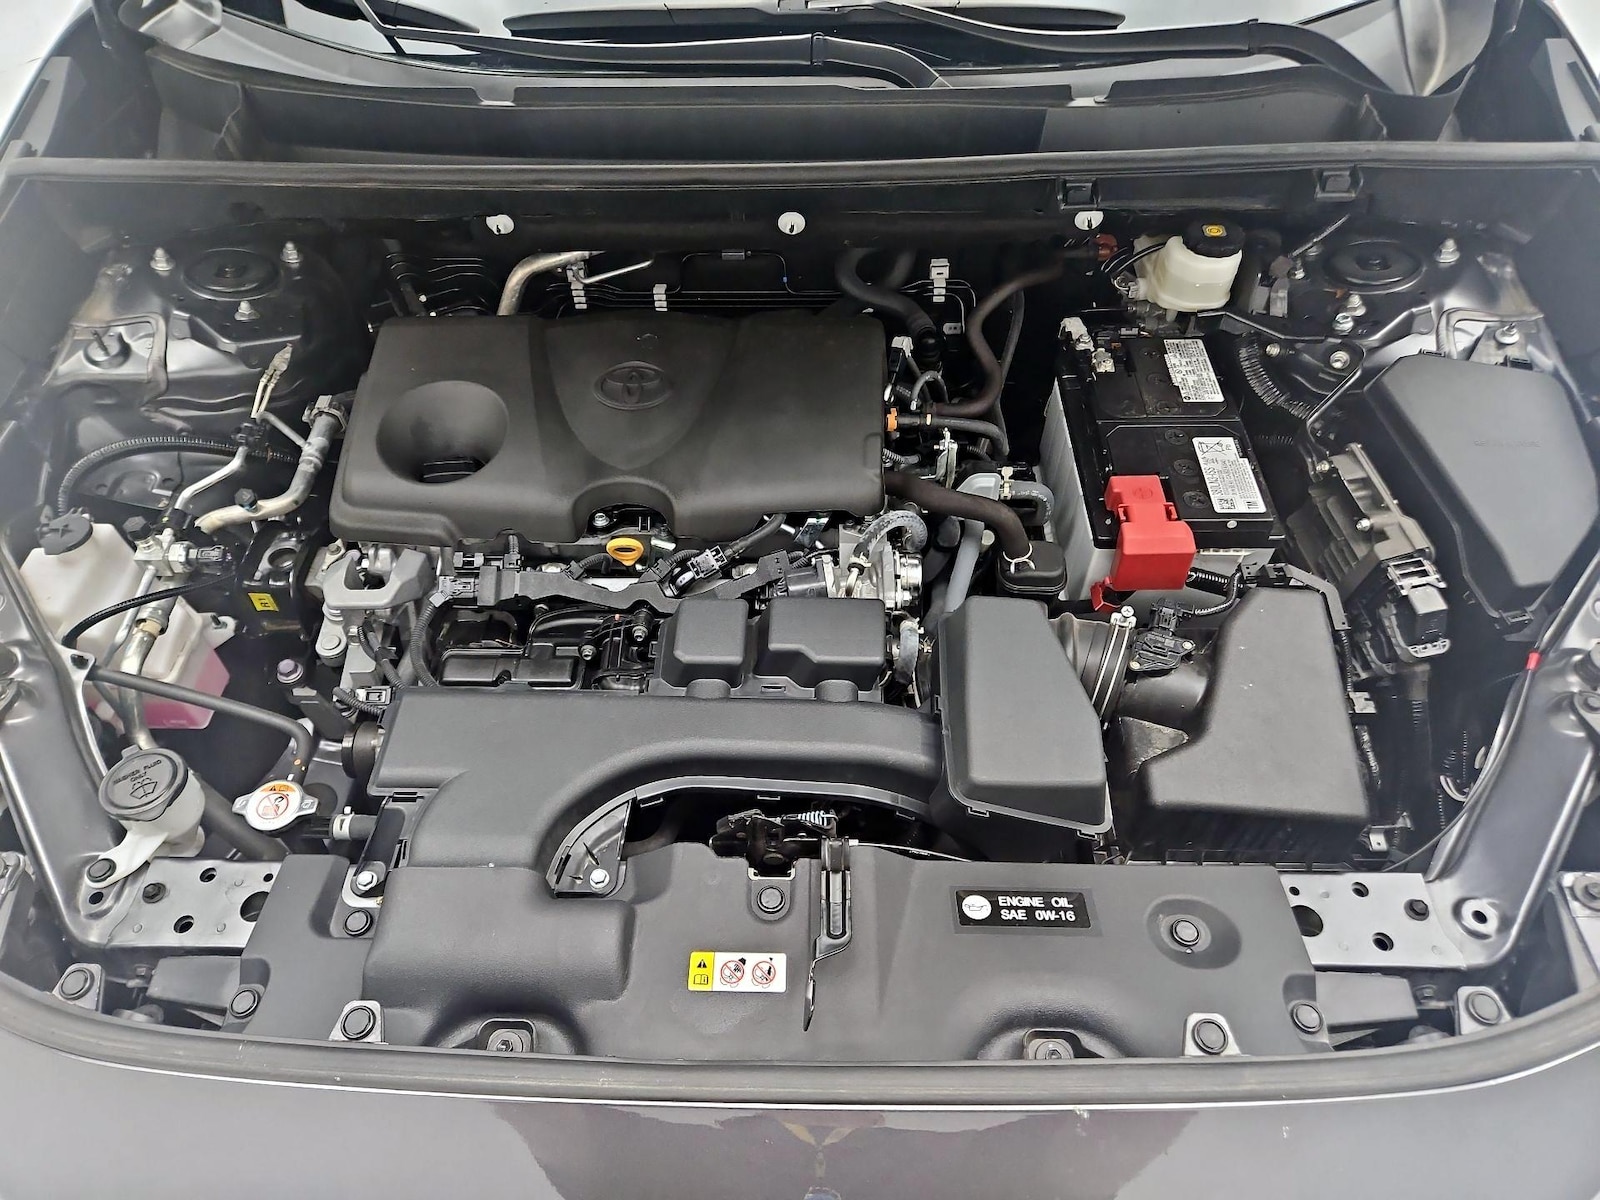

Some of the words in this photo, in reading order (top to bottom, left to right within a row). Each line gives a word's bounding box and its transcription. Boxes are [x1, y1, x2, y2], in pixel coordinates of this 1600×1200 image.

[143, 759, 162, 771] FLUID
[130, 771, 147, 782] ONLY
[997, 896, 1045, 908] ENGINE
[1051, 897, 1074, 908] OIL
[1000, 909, 1028, 920] SAE
[1035, 910, 1076, 921] 0W-16
